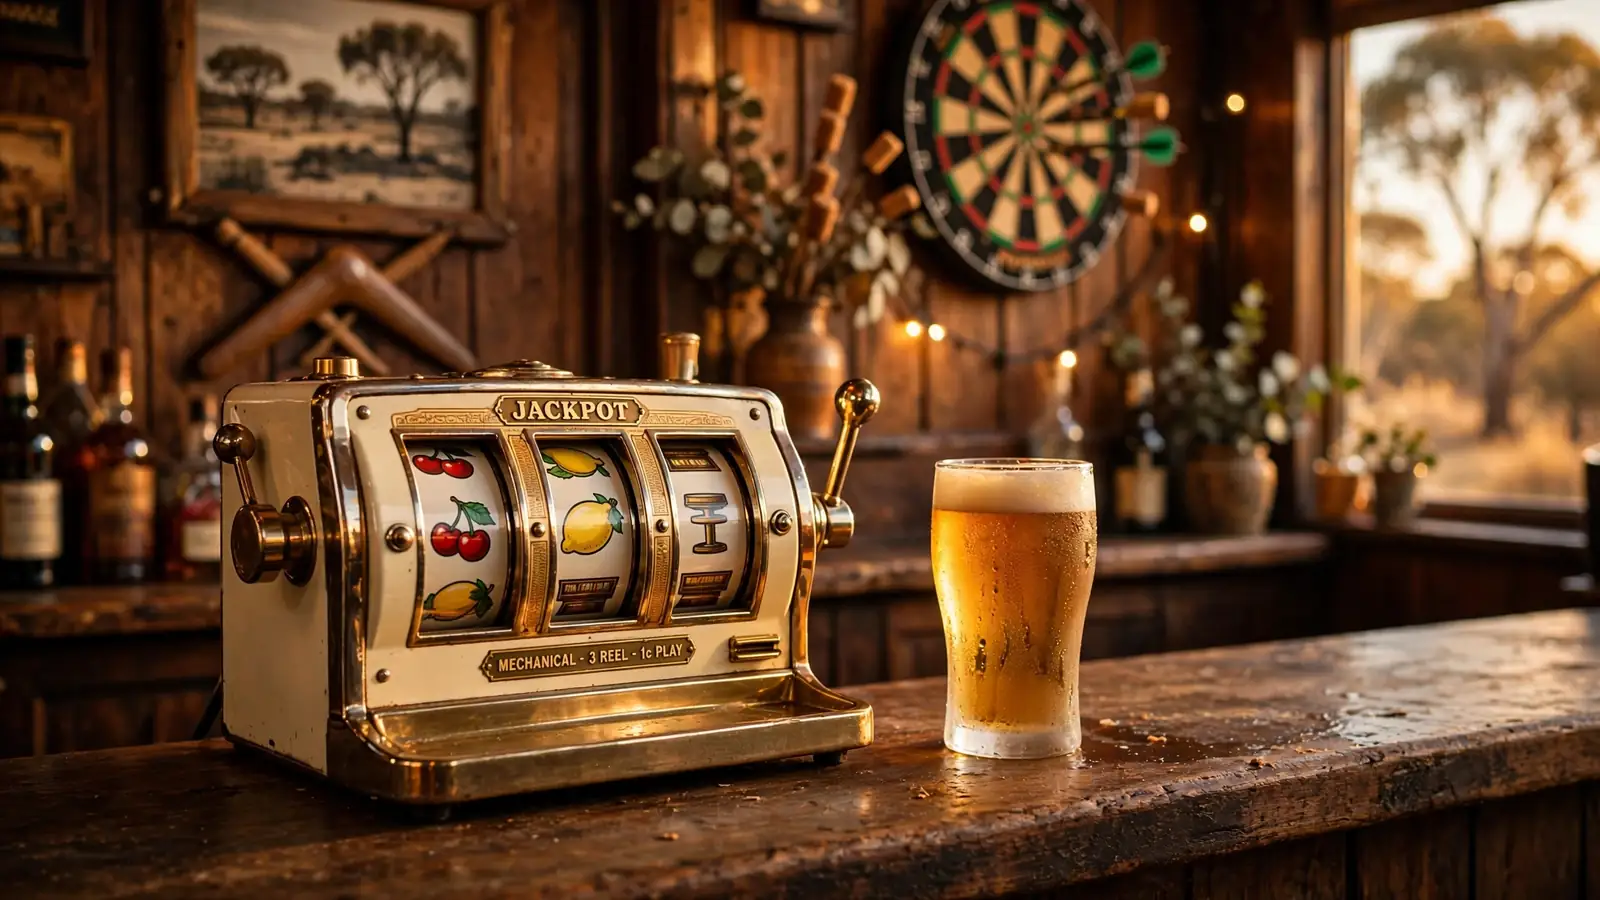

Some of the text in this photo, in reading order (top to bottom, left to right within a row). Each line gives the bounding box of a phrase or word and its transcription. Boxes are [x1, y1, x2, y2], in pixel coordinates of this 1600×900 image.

[512, 400, 629, 420] JACKPOT
[498, 654, 577, 672] MECHANICAL
[589, 651, 596, 665] 3
[600, 648, 628, 663] REEL
[640, 646, 652, 660] 1c
[655, 643, 683, 658] PLAY
